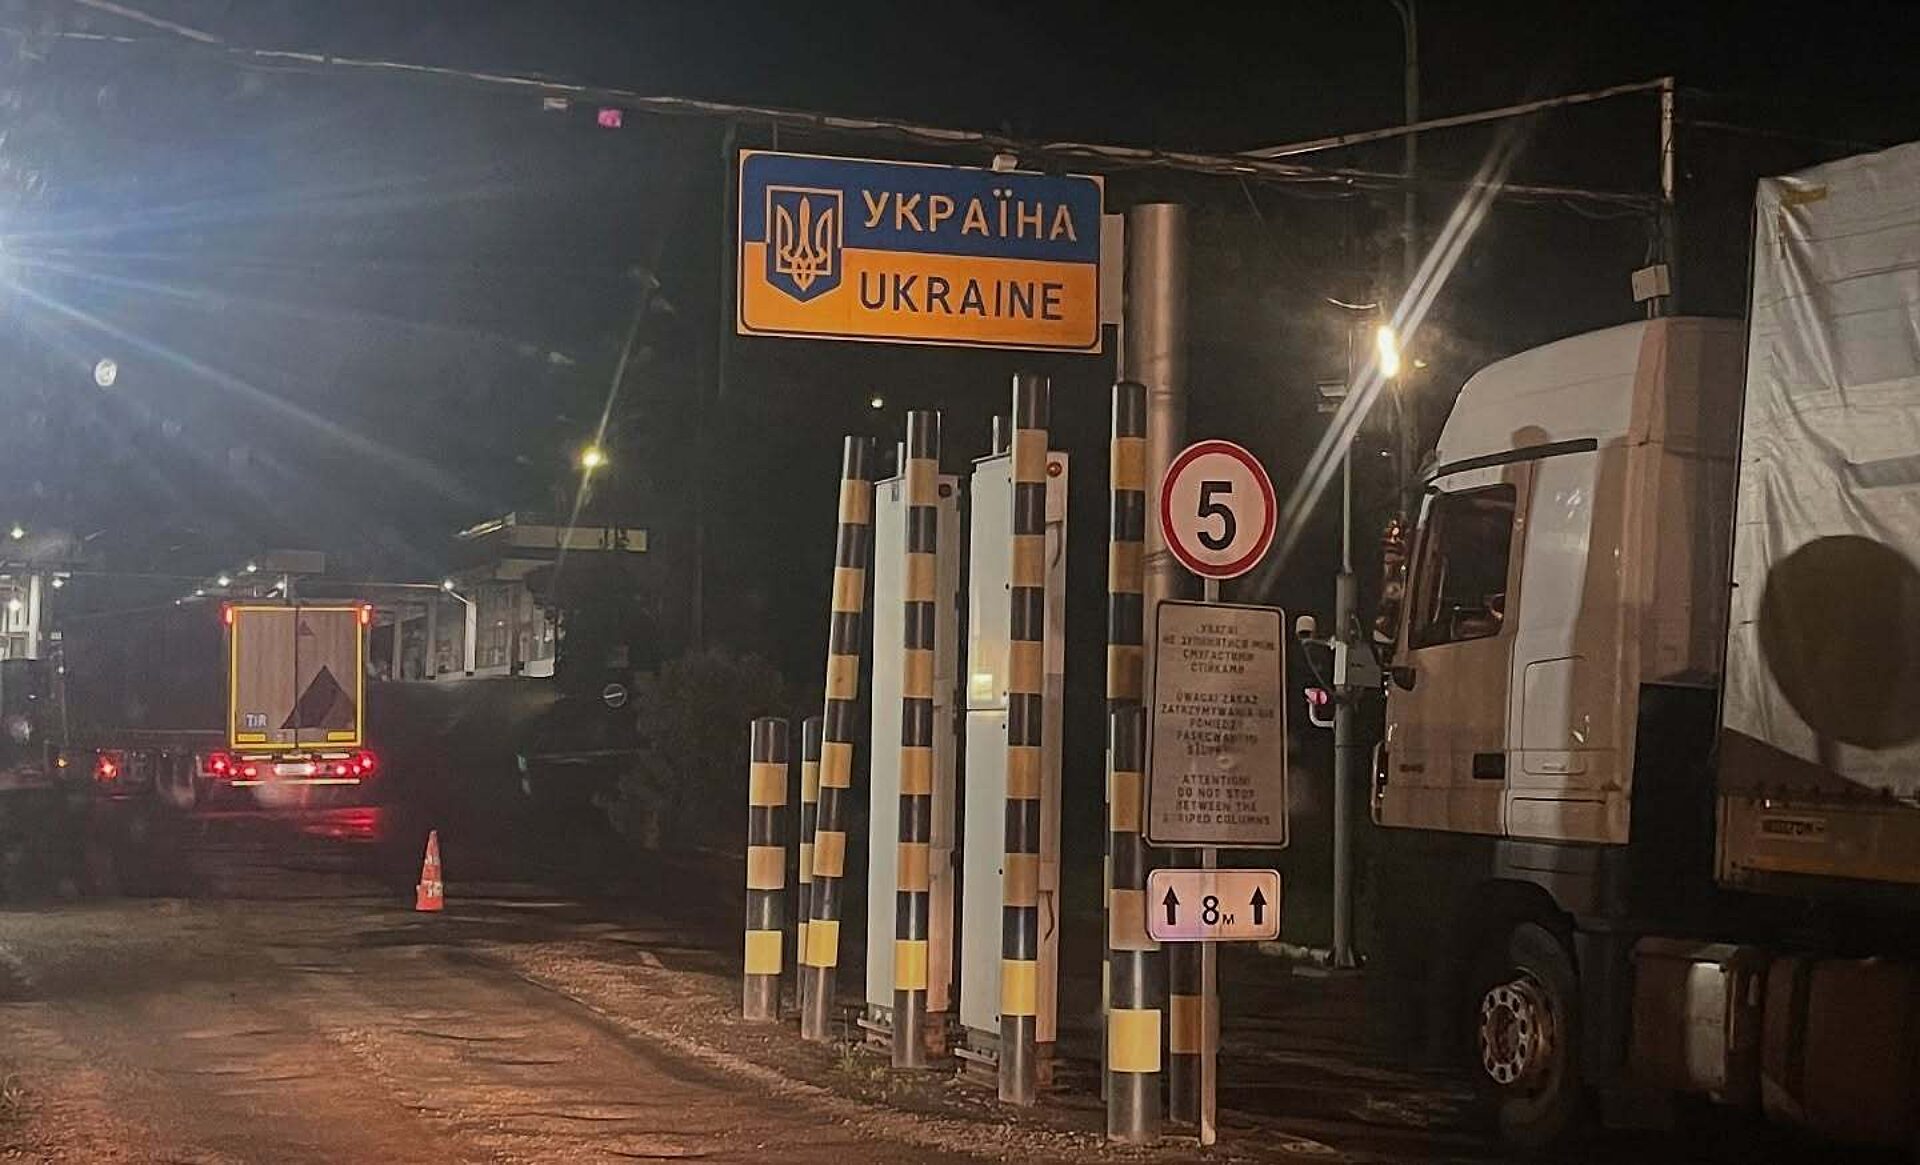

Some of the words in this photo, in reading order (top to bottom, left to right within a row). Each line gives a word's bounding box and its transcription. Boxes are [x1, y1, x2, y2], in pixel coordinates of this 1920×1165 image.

[862, 188, 1078, 244] УКРАЇНА
[859, 270, 1064, 320] UKRAINE
[1197, 481, 1236, 550] 5
[1181, 636, 1249, 649] ЗУЯТИСЯ
[1161, 703, 1253, 716] ZATRZYMYWAA
[246, 714, 267, 727] TIR
[1190, 718, 1244, 730] POMIDZ
[1177, 786, 1193, 798] DO
[1198, 788, 1221, 798] NOT
[1226, 788, 1255, 799] STOP
[1176, 800, 1232, 812] BETWEEN
[1236, 801, 1257, 812] THE
[1163, 812, 1211, 824] SRIPED
[1216, 813, 1270, 826] COLUMNS
